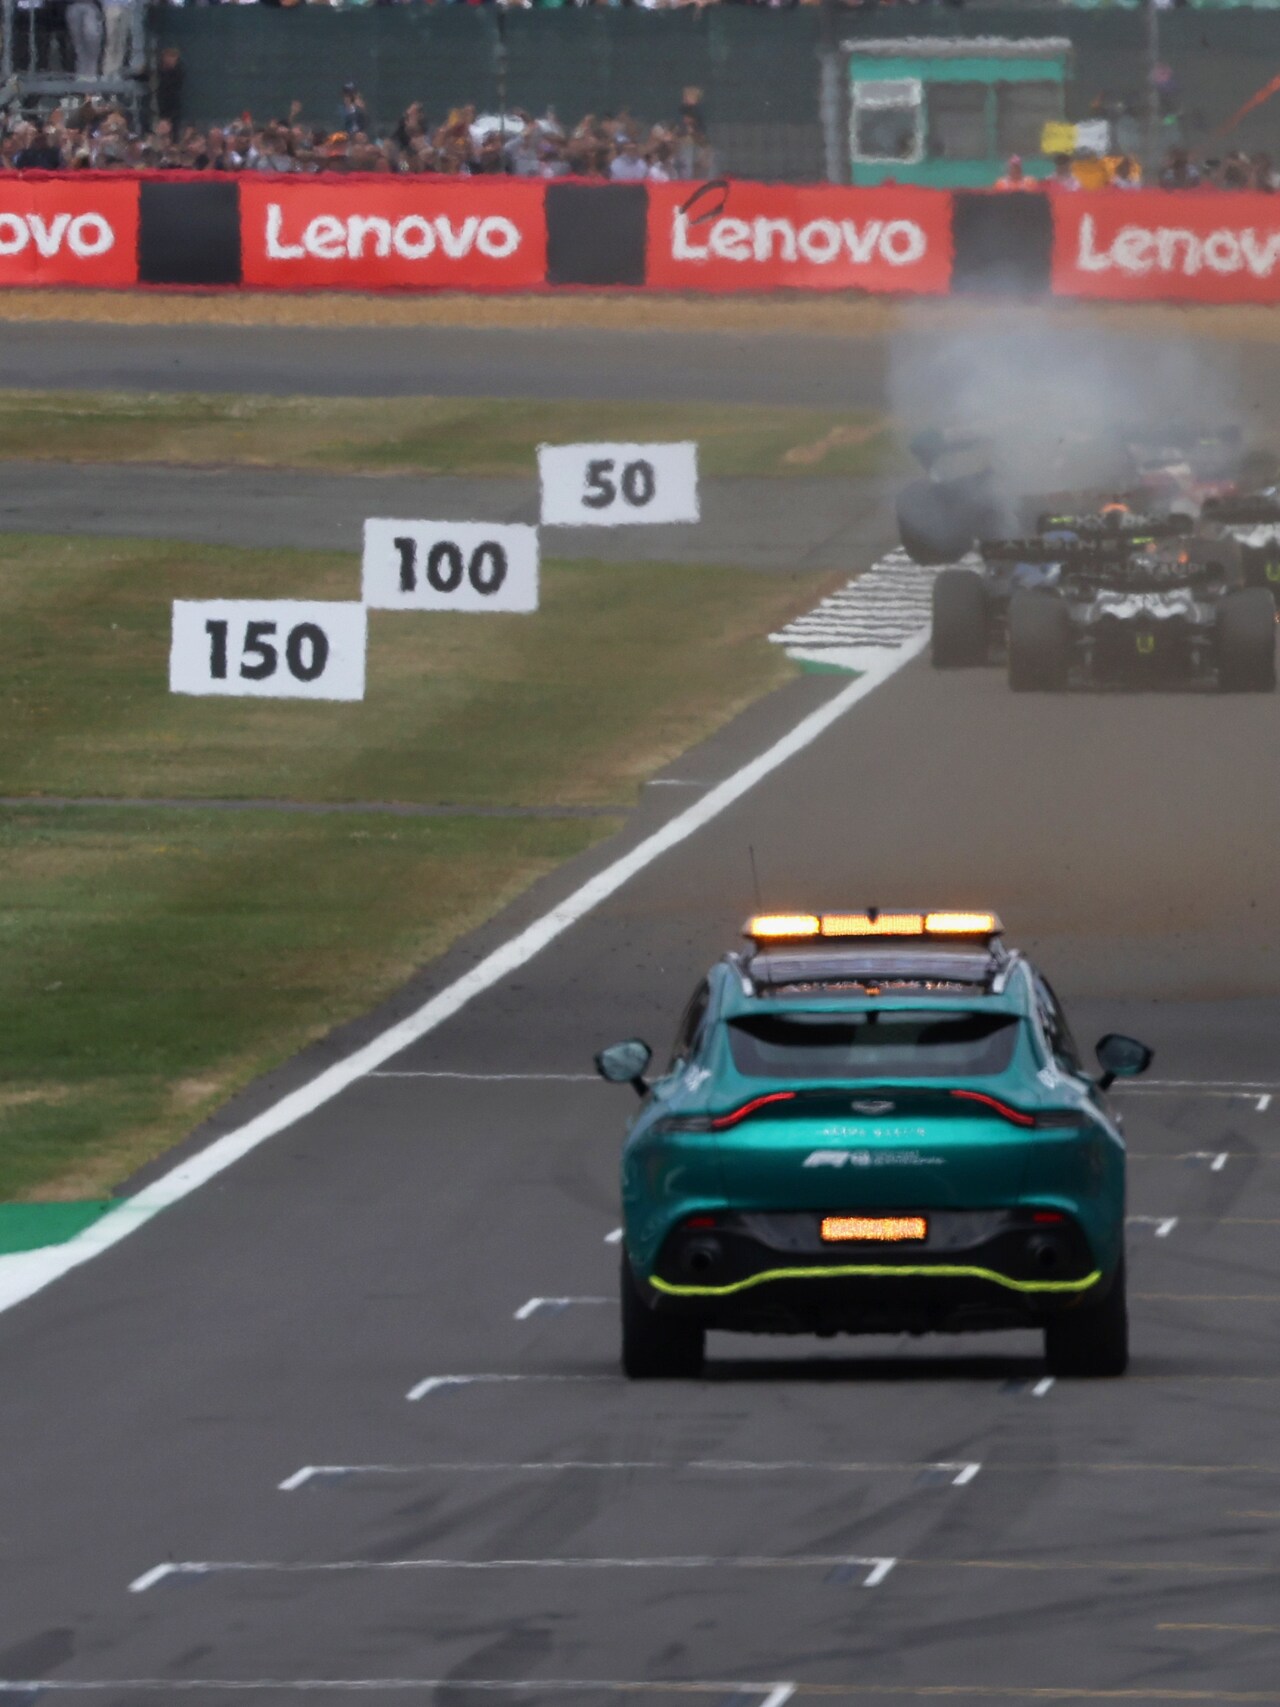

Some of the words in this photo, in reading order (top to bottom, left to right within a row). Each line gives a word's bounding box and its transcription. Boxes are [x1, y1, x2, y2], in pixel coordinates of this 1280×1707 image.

[266, 204, 522, 259] Lenovo
[672, 205, 927, 266] Lenovo
[581, 459, 655, 508] 50
[393, 537, 508, 596] 100
[206, 619, 329, 682] 150
